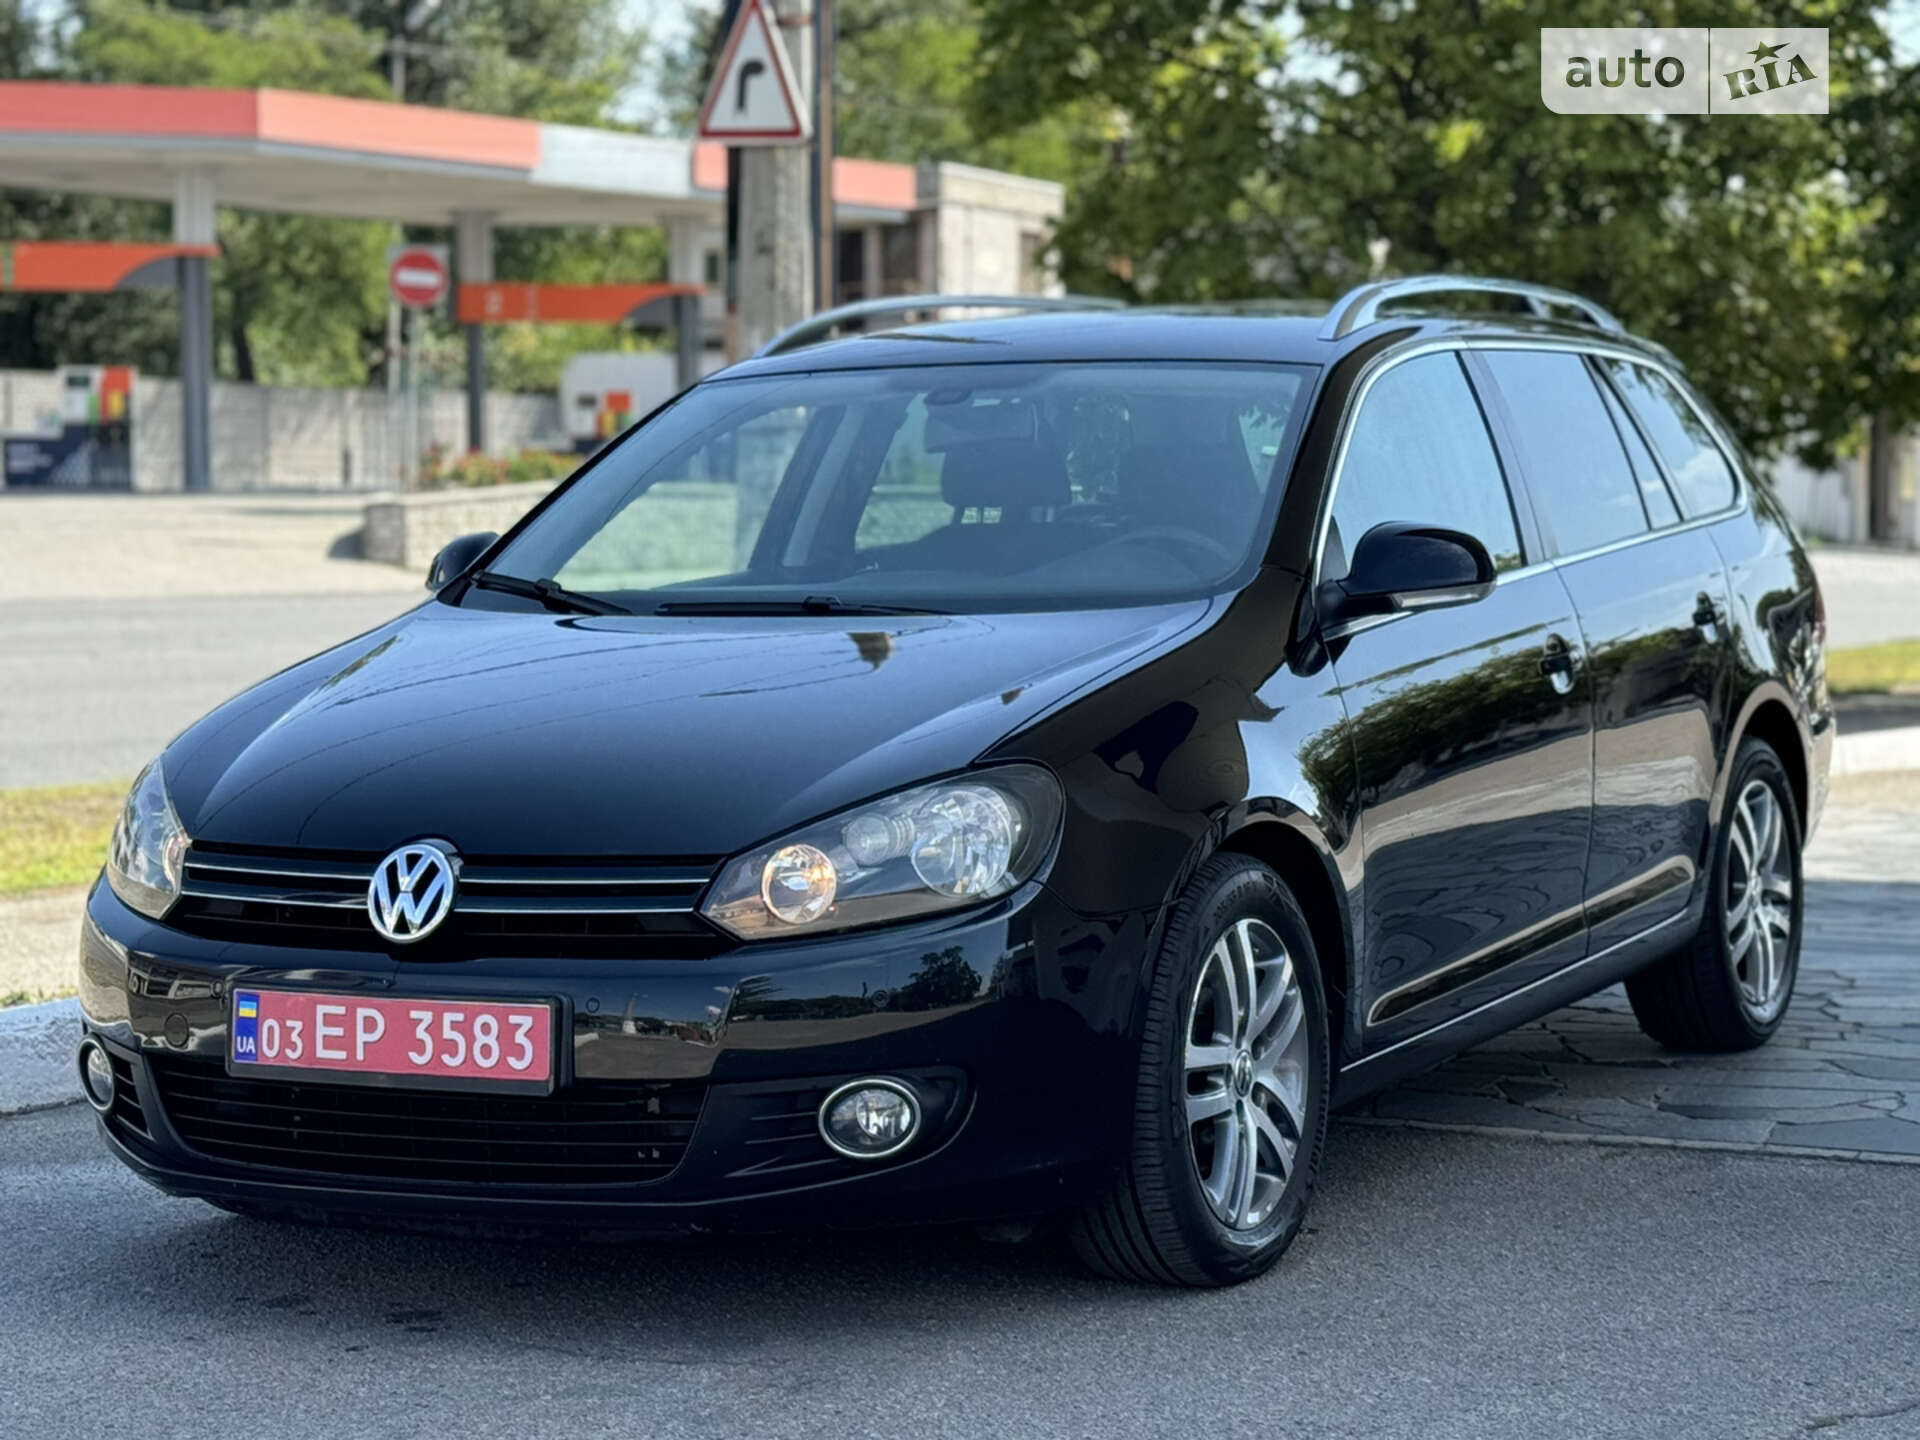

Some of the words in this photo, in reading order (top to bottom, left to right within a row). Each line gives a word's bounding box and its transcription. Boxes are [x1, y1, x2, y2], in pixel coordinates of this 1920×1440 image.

[370, 844, 453, 939] VW
[236, 1035, 256, 1054] UA
[261, 1018, 304, 1060] 03
[314, 1004, 386, 1061] EP
[407, 1010, 534, 1071] 3583
